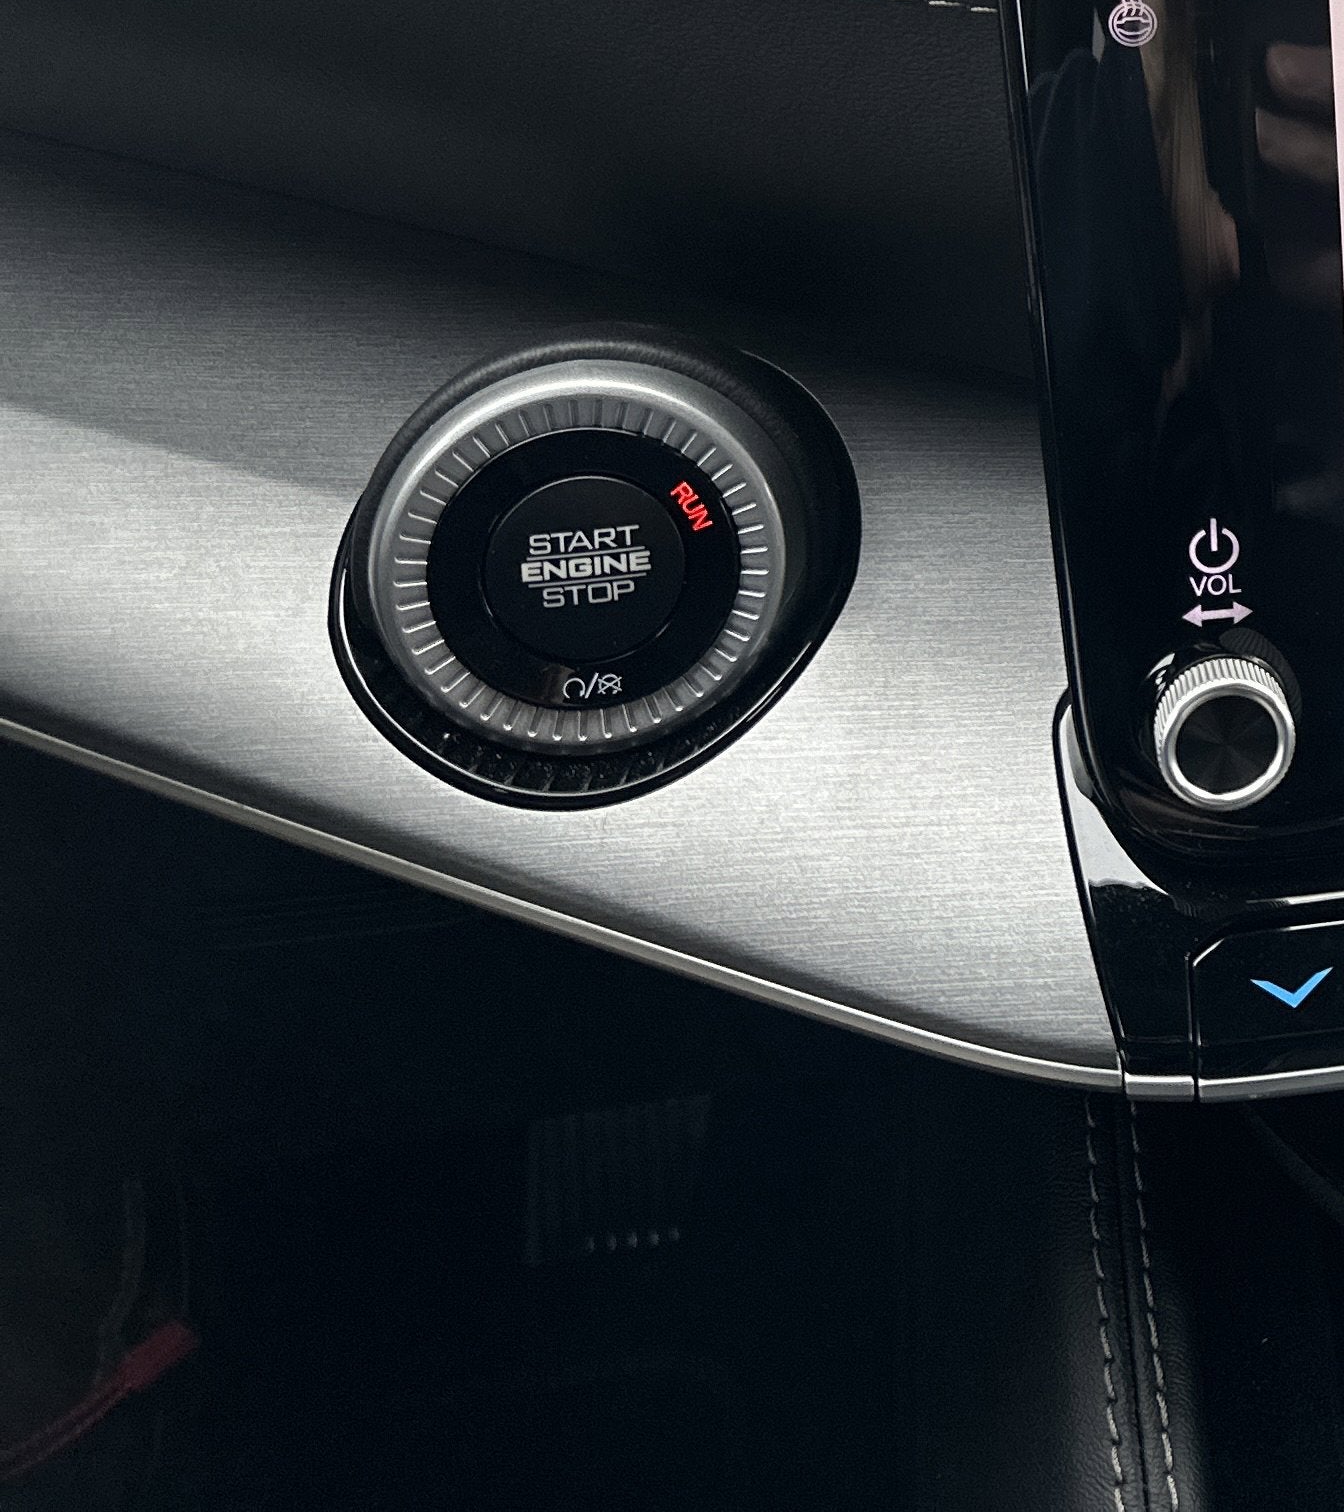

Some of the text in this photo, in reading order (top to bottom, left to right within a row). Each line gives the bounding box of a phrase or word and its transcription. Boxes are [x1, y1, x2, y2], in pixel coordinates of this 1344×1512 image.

[670, 479, 716, 532] RUN
[528, 524, 640, 555] START
[520, 549, 652, 584] ENGINE
[541, 579, 636, 608] STOP
[1189, 573, 1242, 596] VOL
